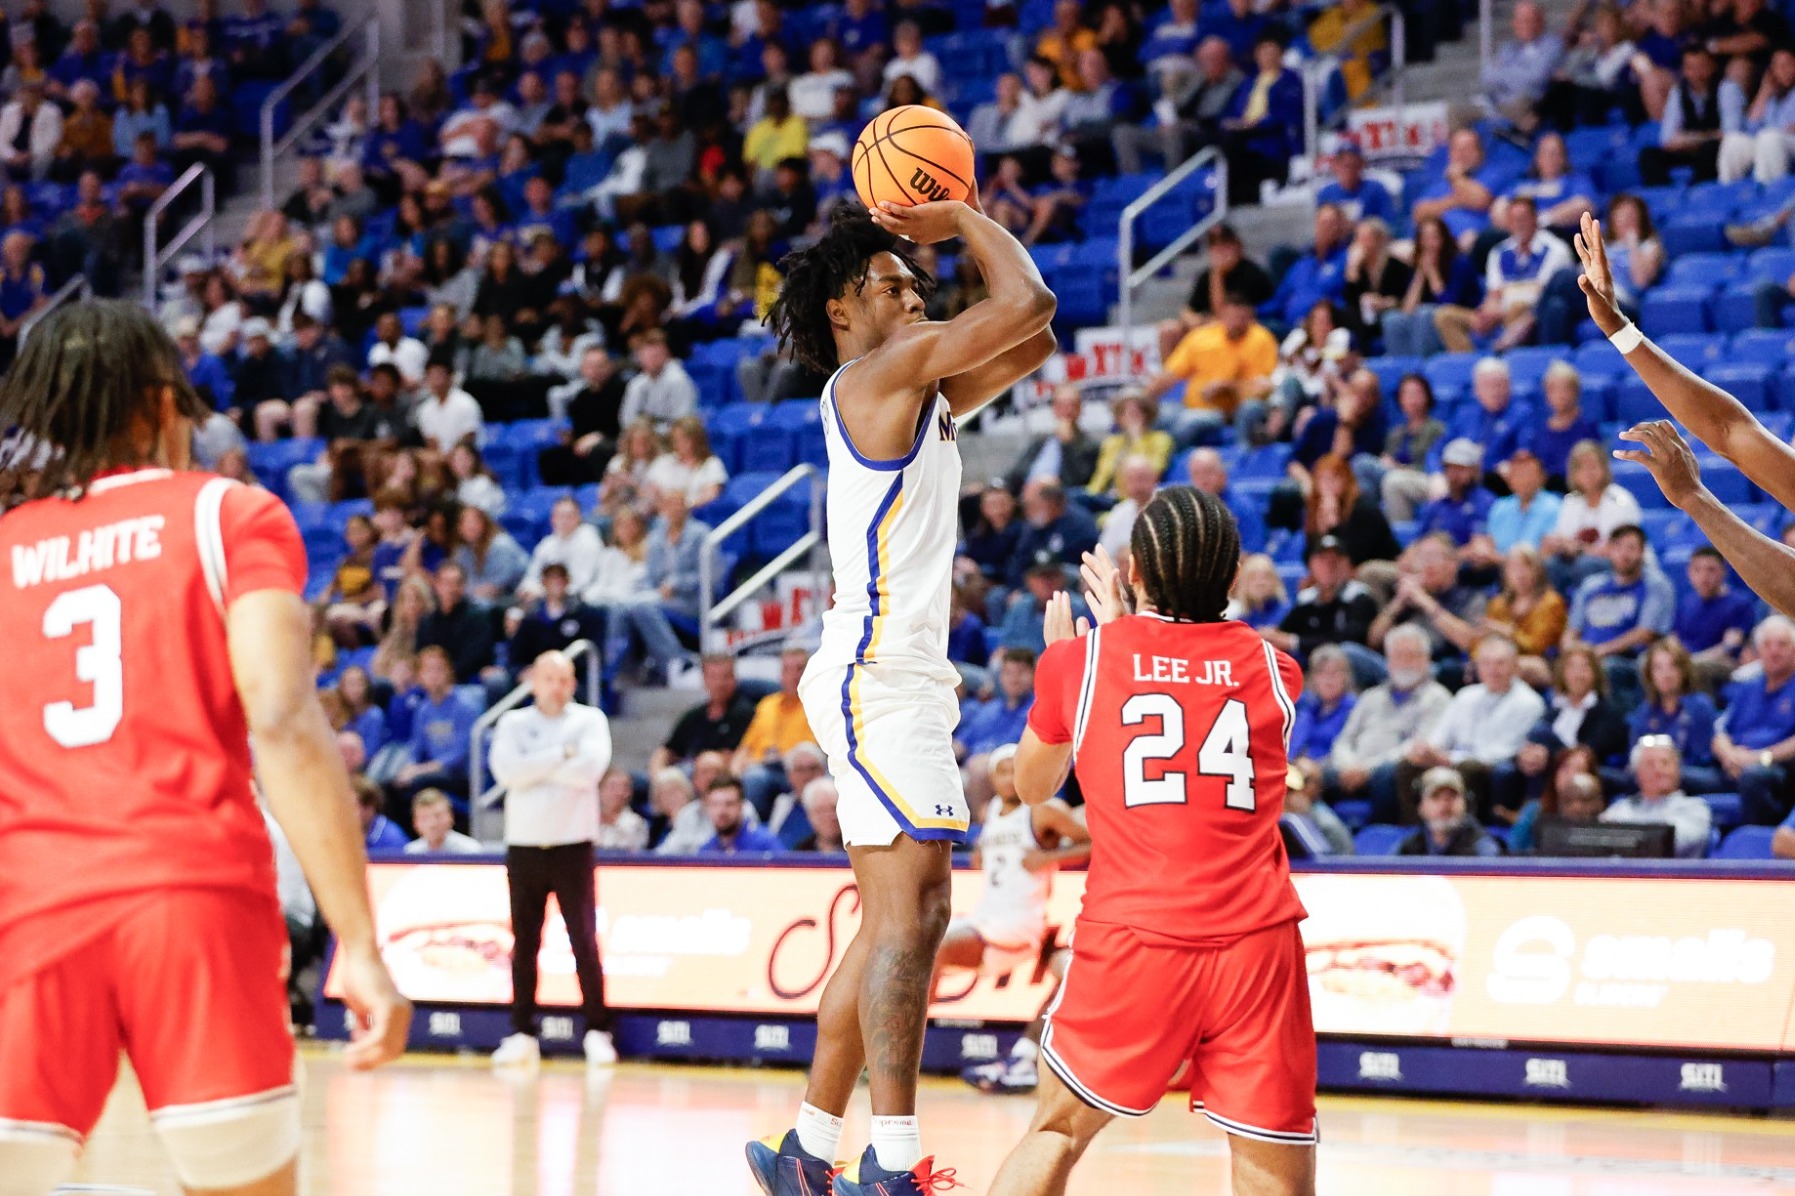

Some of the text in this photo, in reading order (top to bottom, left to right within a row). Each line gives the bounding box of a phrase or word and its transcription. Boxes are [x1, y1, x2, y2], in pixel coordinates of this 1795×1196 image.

[910, 167, 951, 202] Wil
[11, 514, 166, 588] WILHITE
[42, 584, 123, 748] 3
[1133, 653, 1240, 687] LEE JR.
[1121, 692, 1256, 813] 24
